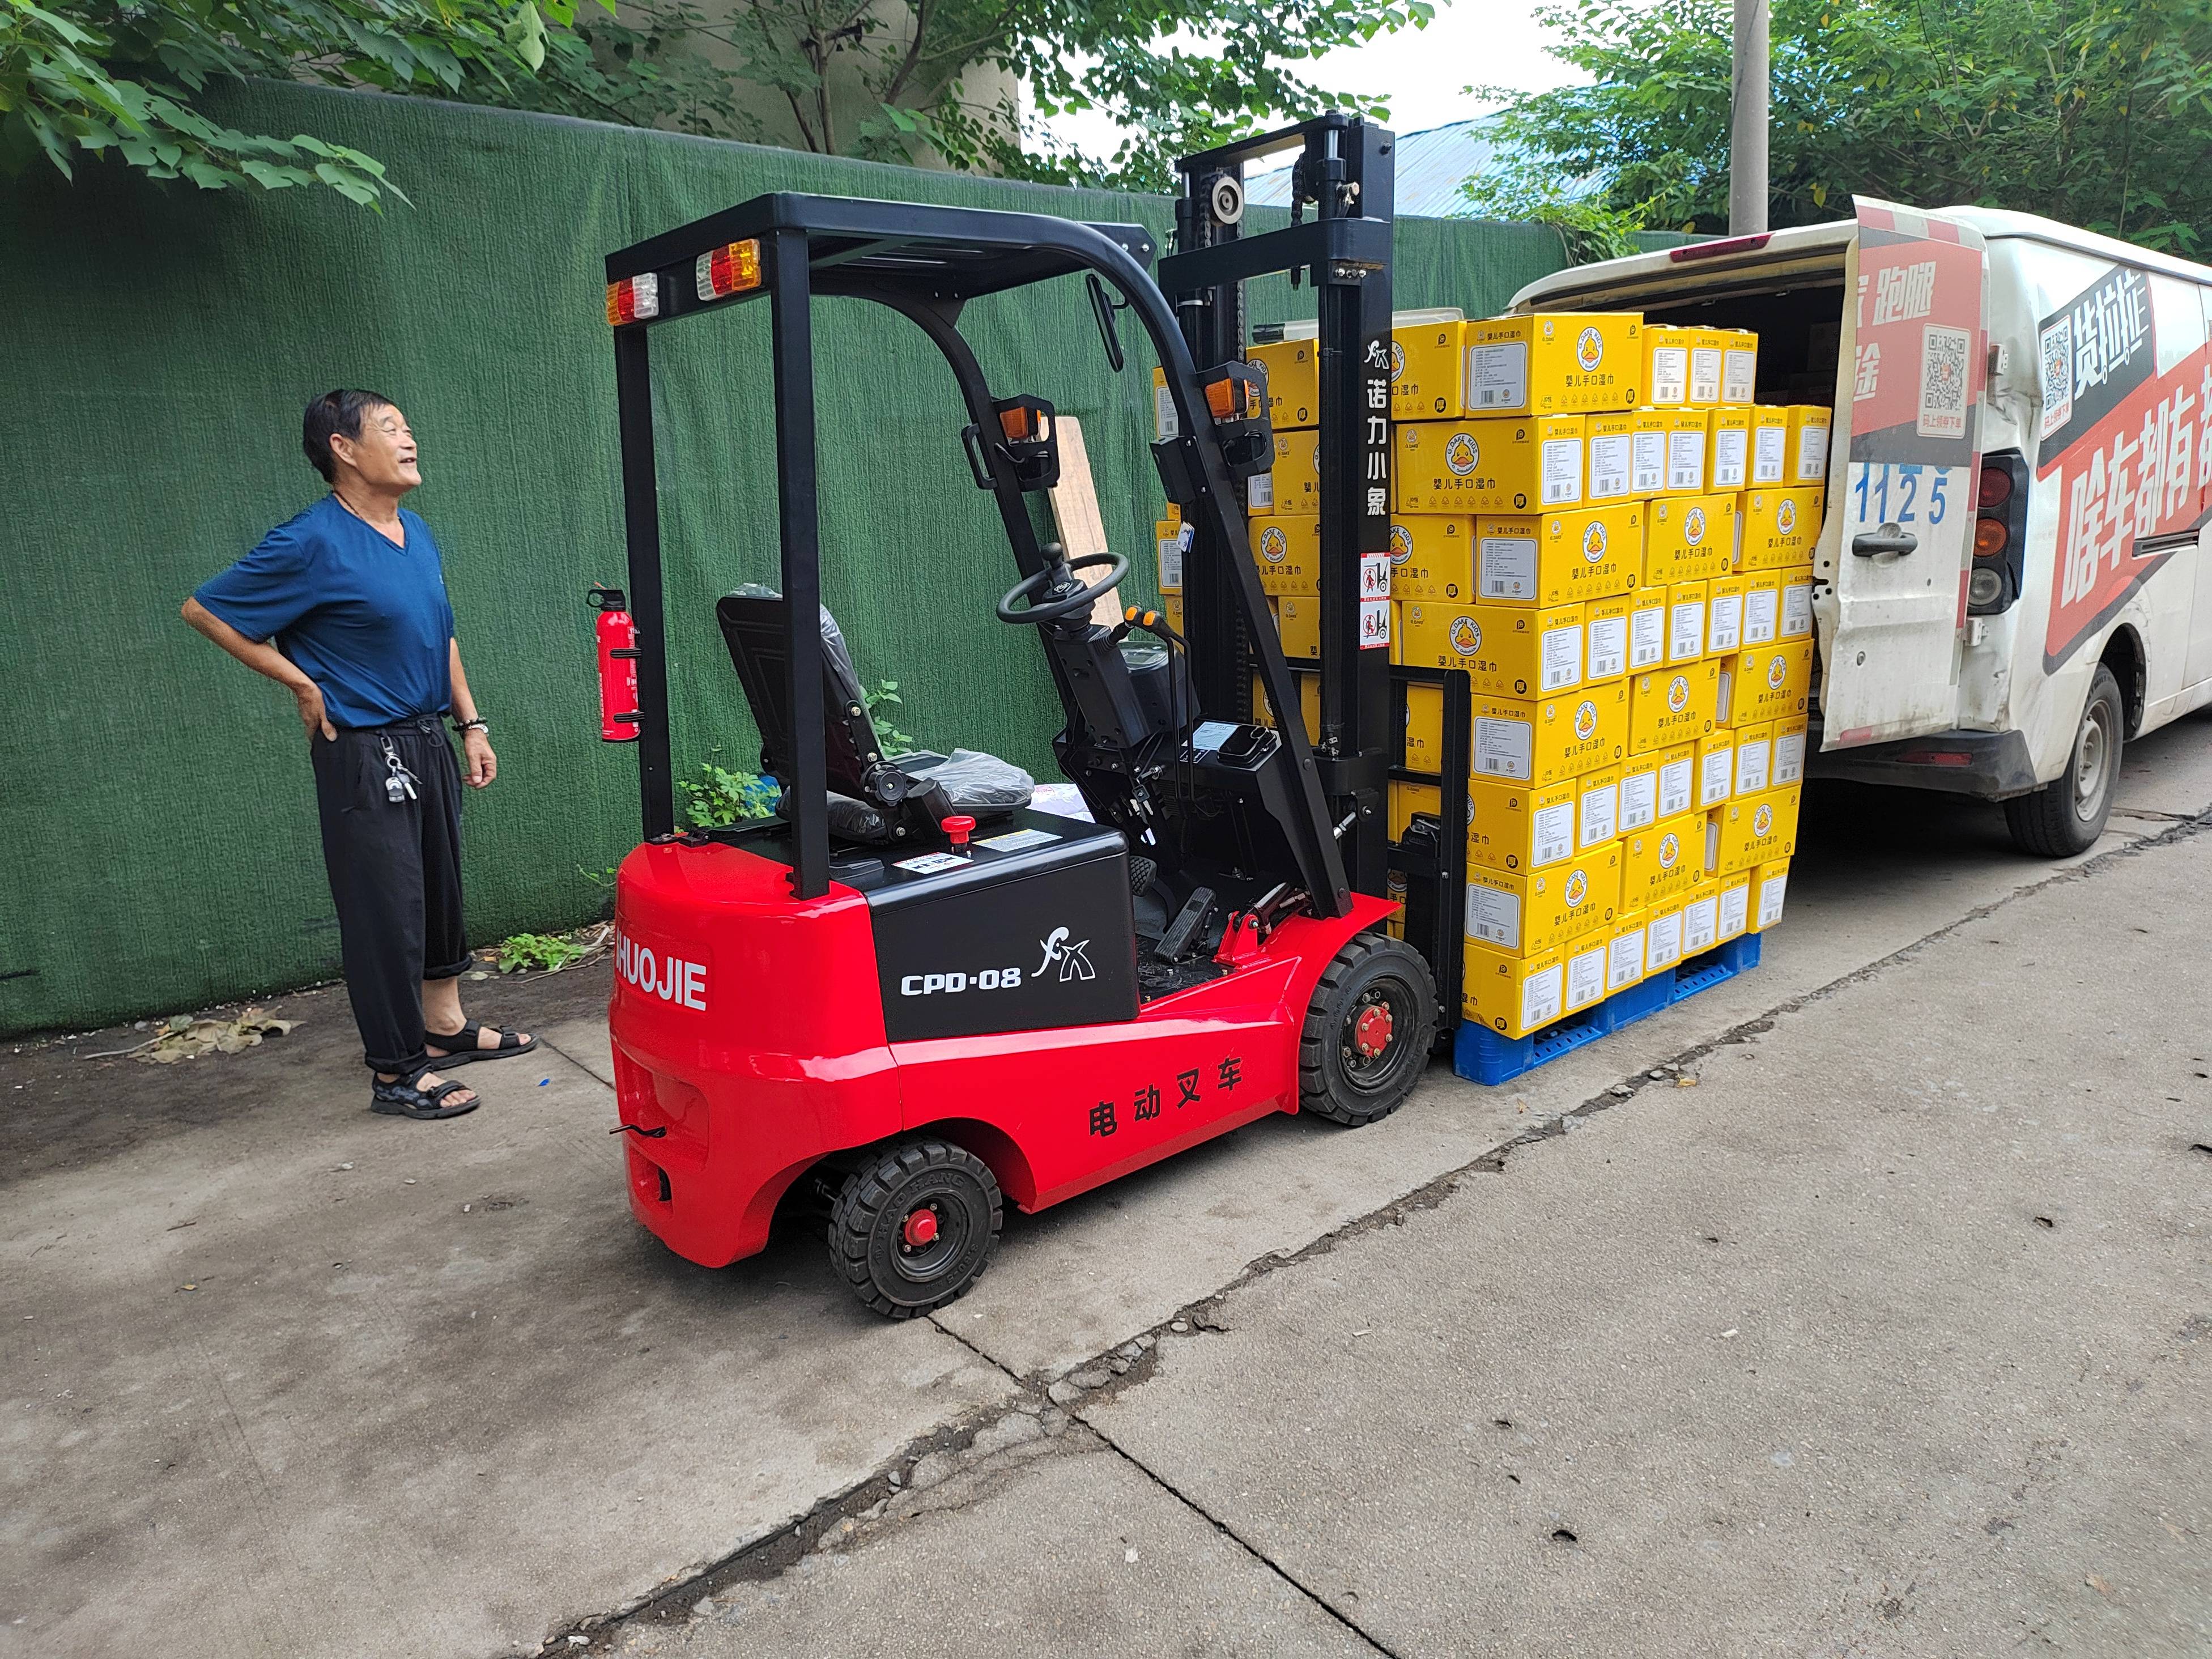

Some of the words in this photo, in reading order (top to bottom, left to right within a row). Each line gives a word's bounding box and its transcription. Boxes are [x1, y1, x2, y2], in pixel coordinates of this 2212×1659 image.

[2074, 268, 2149, 401] 货拉拉
[1566, 373, 1614, 388] 婴儿手口湿巾
[1367, 378, 1387, 516] 诺力小象
[1467, 438, 1478, 454] KIDS
[1433, 478, 1495, 490] 婴儿手口湿巾
[1855, 473, 1946, 525] 1125
[1674, 546, 1712, 561] 婴儿手口湿巾
[1257, 565, 1301, 575] 儿手口湿巾
[1572, 563, 1617, 580] 婴儿手口湿巾
[1470, 620, 1480, 637] KIDS
[1438, 655, 1498, 673] 婴儿手口湿巾
[1658, 712, 1696, 729] 婴儿手口湿巾
[1564, 737, 1605, 758] 婴儿手口湿巾
[1554, 902, 1596, 927] 婴儿手口湿巾
[1089, 1057, 1243, 1137] 电动叉车
